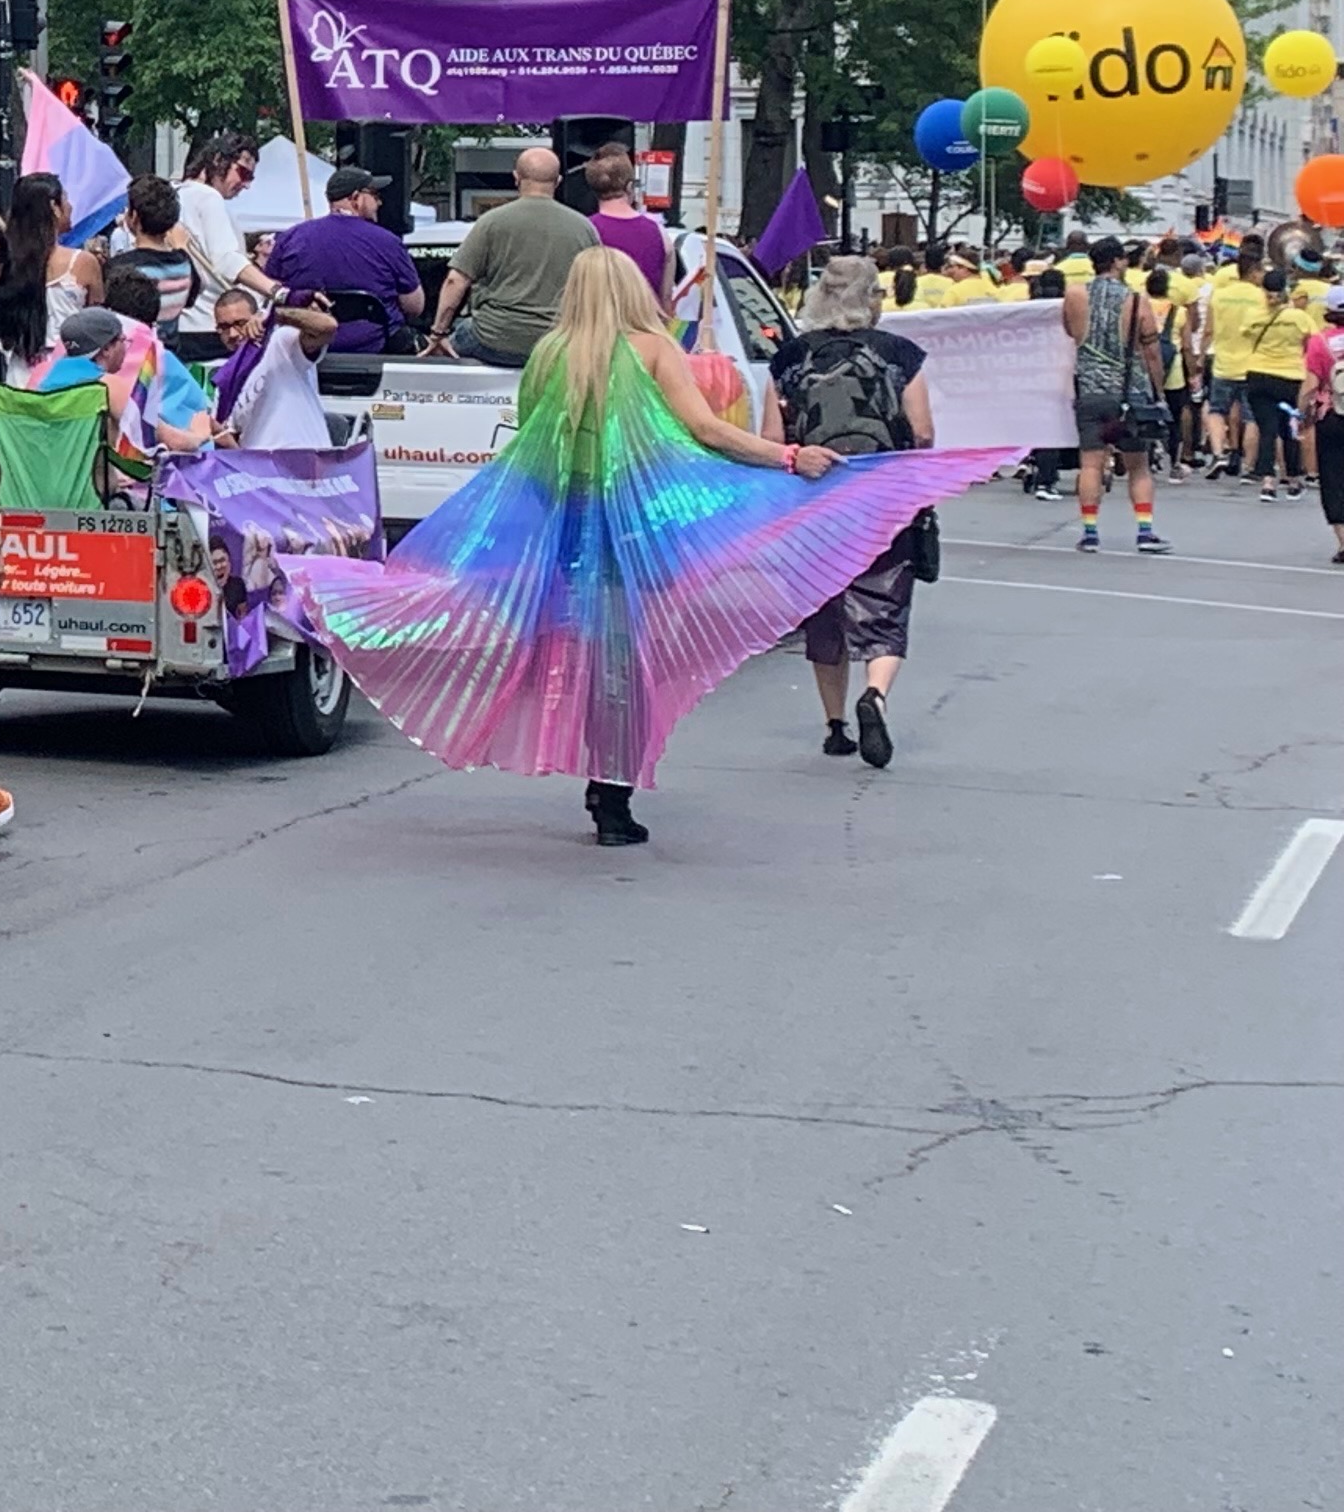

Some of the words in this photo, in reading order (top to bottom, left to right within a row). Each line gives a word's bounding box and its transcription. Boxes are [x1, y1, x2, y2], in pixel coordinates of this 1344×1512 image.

[446, 47, 490, 63] AIDE
[492, 47, 529, 63] AUX
[532, 46, 592, 62] TRANS
[595, 46, 621, 61] DU
[624, 43, 698, 63] QUÉBEC
[325, 49, 442, 96] ATQ
[1046, 26, 1192, 101] do
[383, 389, 433, 404] Partage
[437, 391, 453, 403] de
[457, 392, 512, 405] camions
[77, 516, 96, 532] FS
[101, 516, 133, 533] 1278
[12, 579, 47, 593] toute
[49, 580, 96, 595] voiture
[12, 603, 45, 626] 652
[58, 617, 147, 634] uhaul.com
